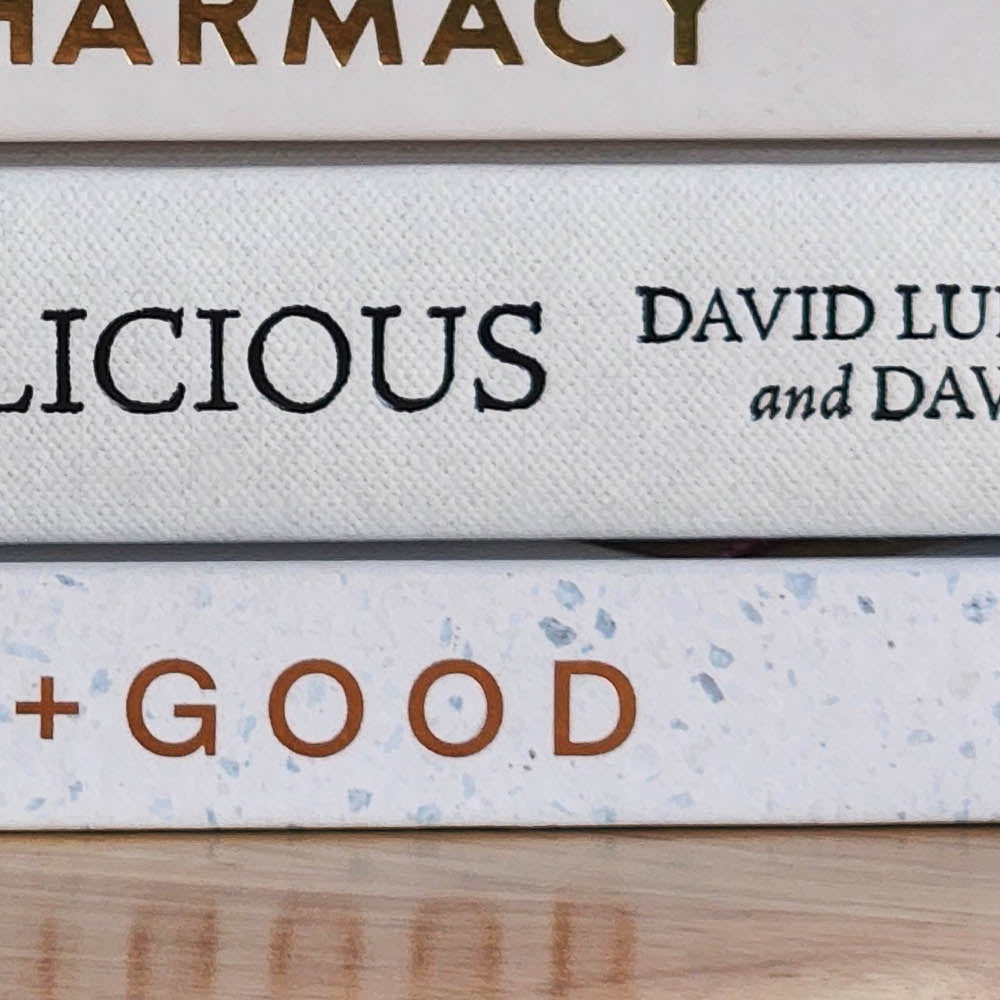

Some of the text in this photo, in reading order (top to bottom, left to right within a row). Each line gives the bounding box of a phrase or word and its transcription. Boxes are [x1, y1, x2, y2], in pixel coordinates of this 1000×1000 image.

[636, 284, 1000, 343] DAVID LU
[750, 363, 853, 420] and
